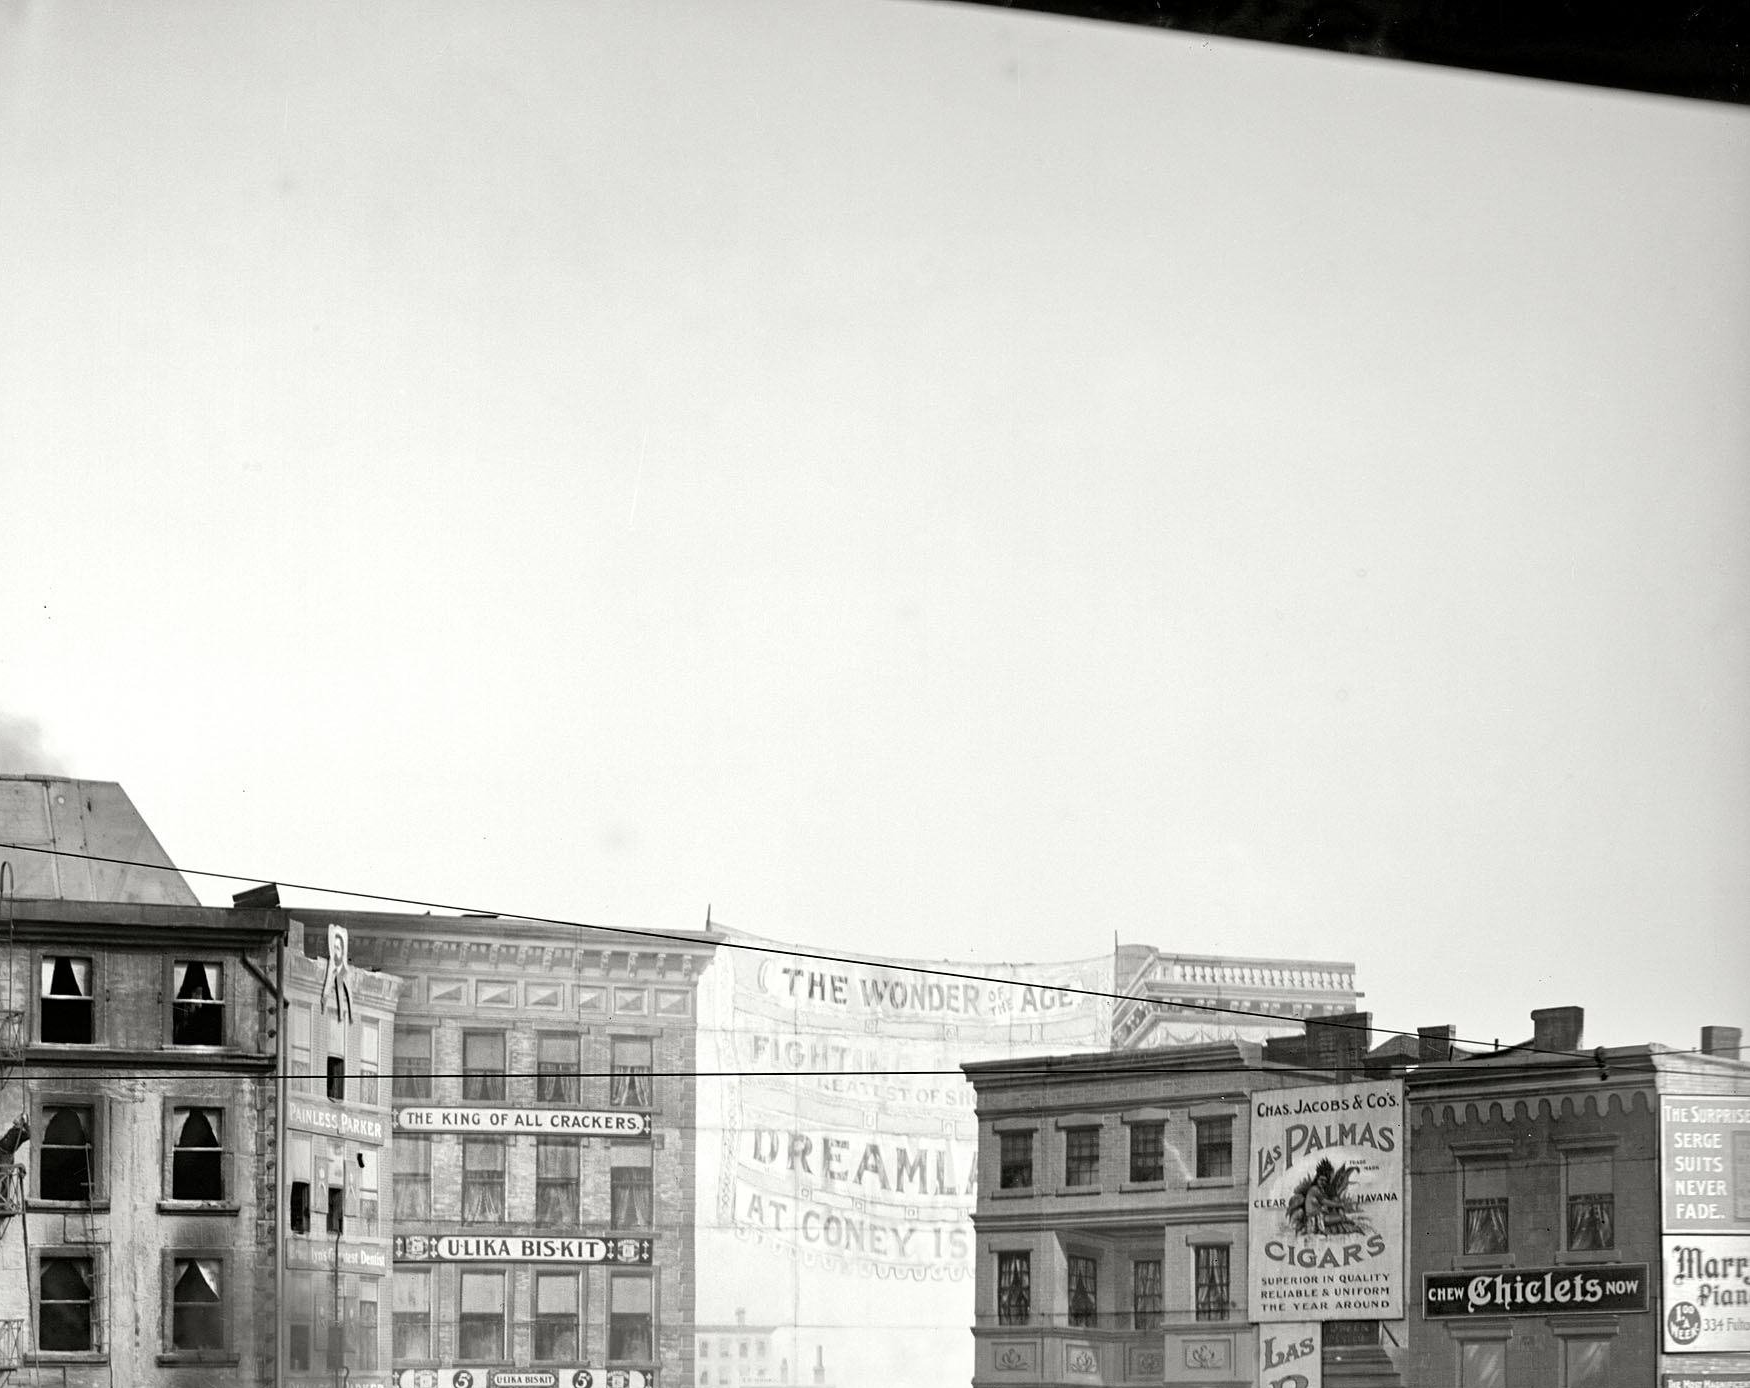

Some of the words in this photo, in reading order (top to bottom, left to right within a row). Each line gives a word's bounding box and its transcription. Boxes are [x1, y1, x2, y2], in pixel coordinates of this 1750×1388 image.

[782, 967, 848, 1005] THE
[859, 978, 980, 1013] WONDER
[1020, 983, 1074, 1012] AGE
[1257, 1102, 1292, 1118] CHAS.
[1294, 1099, 1350, 1114] JACOBS
[1353, 1094, 1363, 1110] &
[1664, 1105, 1689, 1122] THE
[289, 1102, 338, 1129] PAINLESS
[341, 1113, 382, 1138] PARKER
[406, 1112, 434, 1125] THE
[442, 1113, 481, 1126] KING
[489, 1113, 509, 1126] OF
[514, 1114, 543, 1127] ALL
[550, 1114, 640, 1130] CRACKERS.
[1285, 1121, 1395, 1171] PALMAS
[1674, 1132, 1723, 1149] SERGE
[1675, 1156, 1724, 1172] SUITS
[1675, 1180, 1728, 1196] NEVER
[1253, 1199, 1287, 1209] CLEAR
[1357, 1192, 1398, 1204] HAVANA
[1676, 1203, 1726, 1219] FADE.
[747, 1192, 787, 1231] AT
[802, 1210, 916, 1258] CONEY
[360, 1249, 386, 1268] Dentist
[1264, 1234, 1386, 1269] CIGARS
[1261, 1275, 1319, 1286] SUPERIOR
[1323, 1275, 1335, 1283] IN
[1339, 1273, 1391, 1283] QUALITY
[1260, 1288, 1319, 1299] RELIABLE
[1322, 1288, 1330, 1297] &
[1335, 1286, 1390, 1296] UNIFORM
[1428, 1286, 1465, 1301] CHEW
[1467, 1271, 1603, 1314] Chiclets
[1605, 1280, 1639, 1296] NOW
[1261, 1303, 1286, 1312] THE
[1293, 1301, 1328, 1310] YEAR
[1335, 1299, 1390, 1310] AROUND
[1262, 1336, 1315, 1372] LAS
